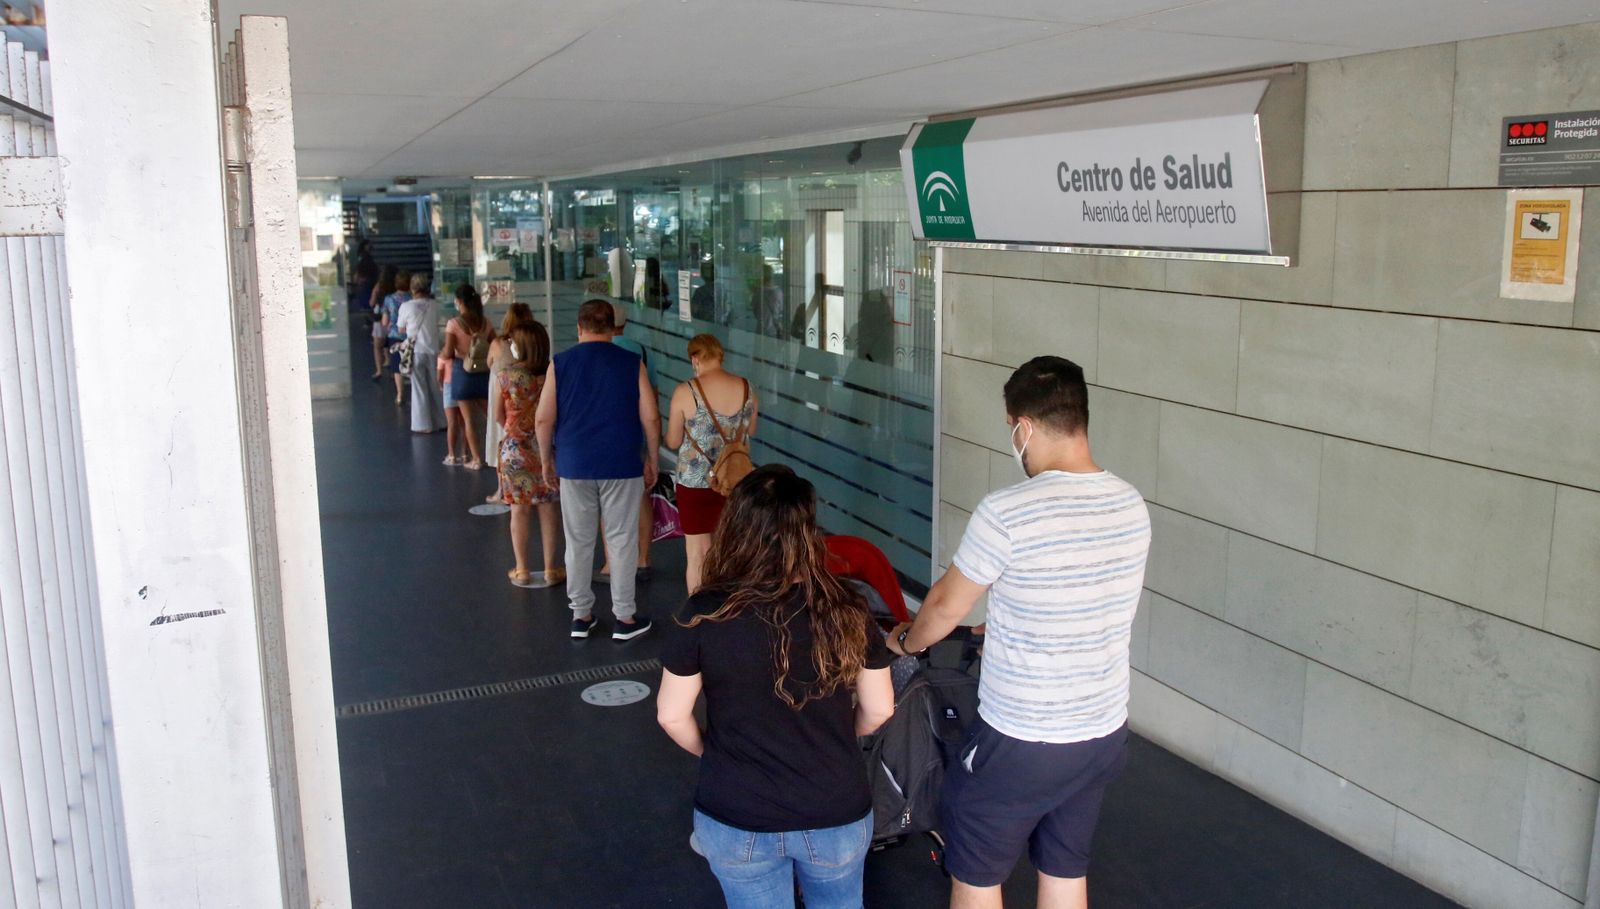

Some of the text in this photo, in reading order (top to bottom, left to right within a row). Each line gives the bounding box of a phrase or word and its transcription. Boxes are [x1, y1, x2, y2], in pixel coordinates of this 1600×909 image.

[1509, 137, 1545, 145] SECURITAS
[1554, 128, 1598, 139] Protegida
[1057, 152, 1233, 192] Centro de Salud
[1082, 200, 1236, 228] Avenida del Aeropuerto
